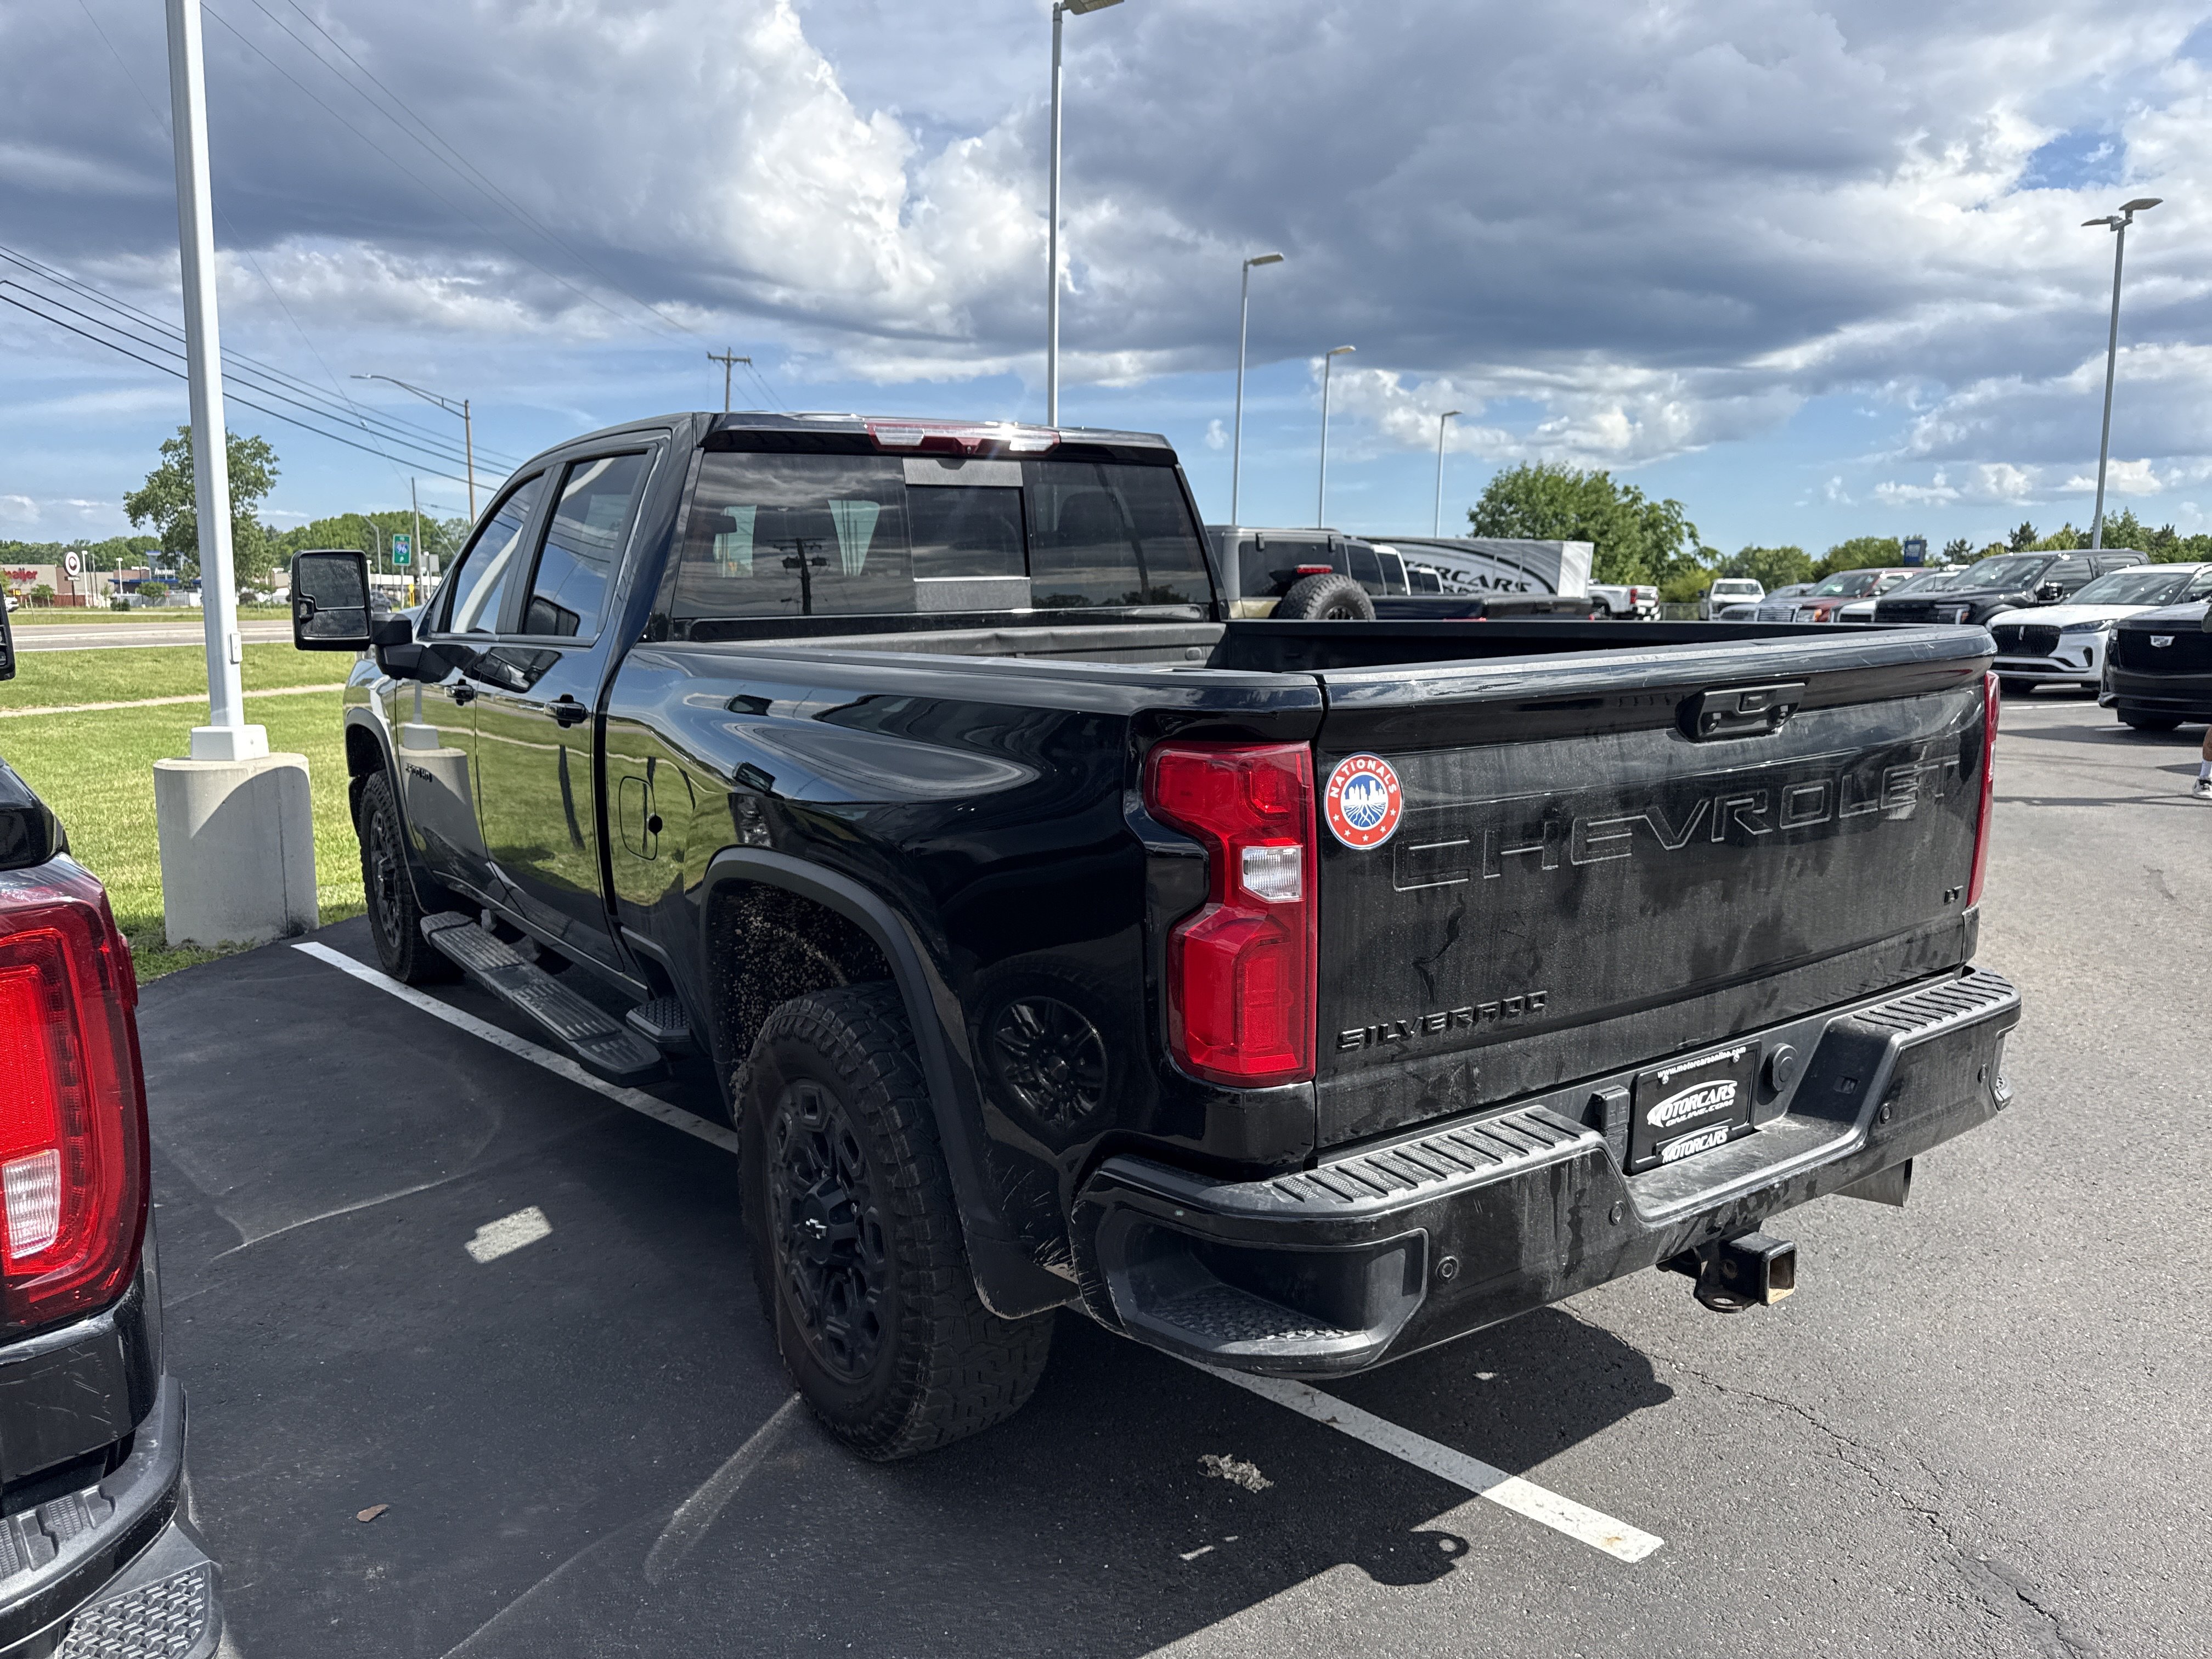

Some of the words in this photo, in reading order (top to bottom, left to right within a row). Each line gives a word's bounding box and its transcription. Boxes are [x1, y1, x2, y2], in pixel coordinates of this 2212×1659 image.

[1329, 759, 1397, 798] NATIONALS
[1393, 754, 1960, 892] CHEVROLET
[1336, 990, 1548, 1050] SILVERADO
[1657, 1046, 1746, 1079] www.motorcarsonline.com
[1647, 1081, 1737, 1128] MOTORCARS
[1665, 1099, 1734, 1127] ONLINE.COM
[1662, 1128, 1729, 1164] MOTORCARS
